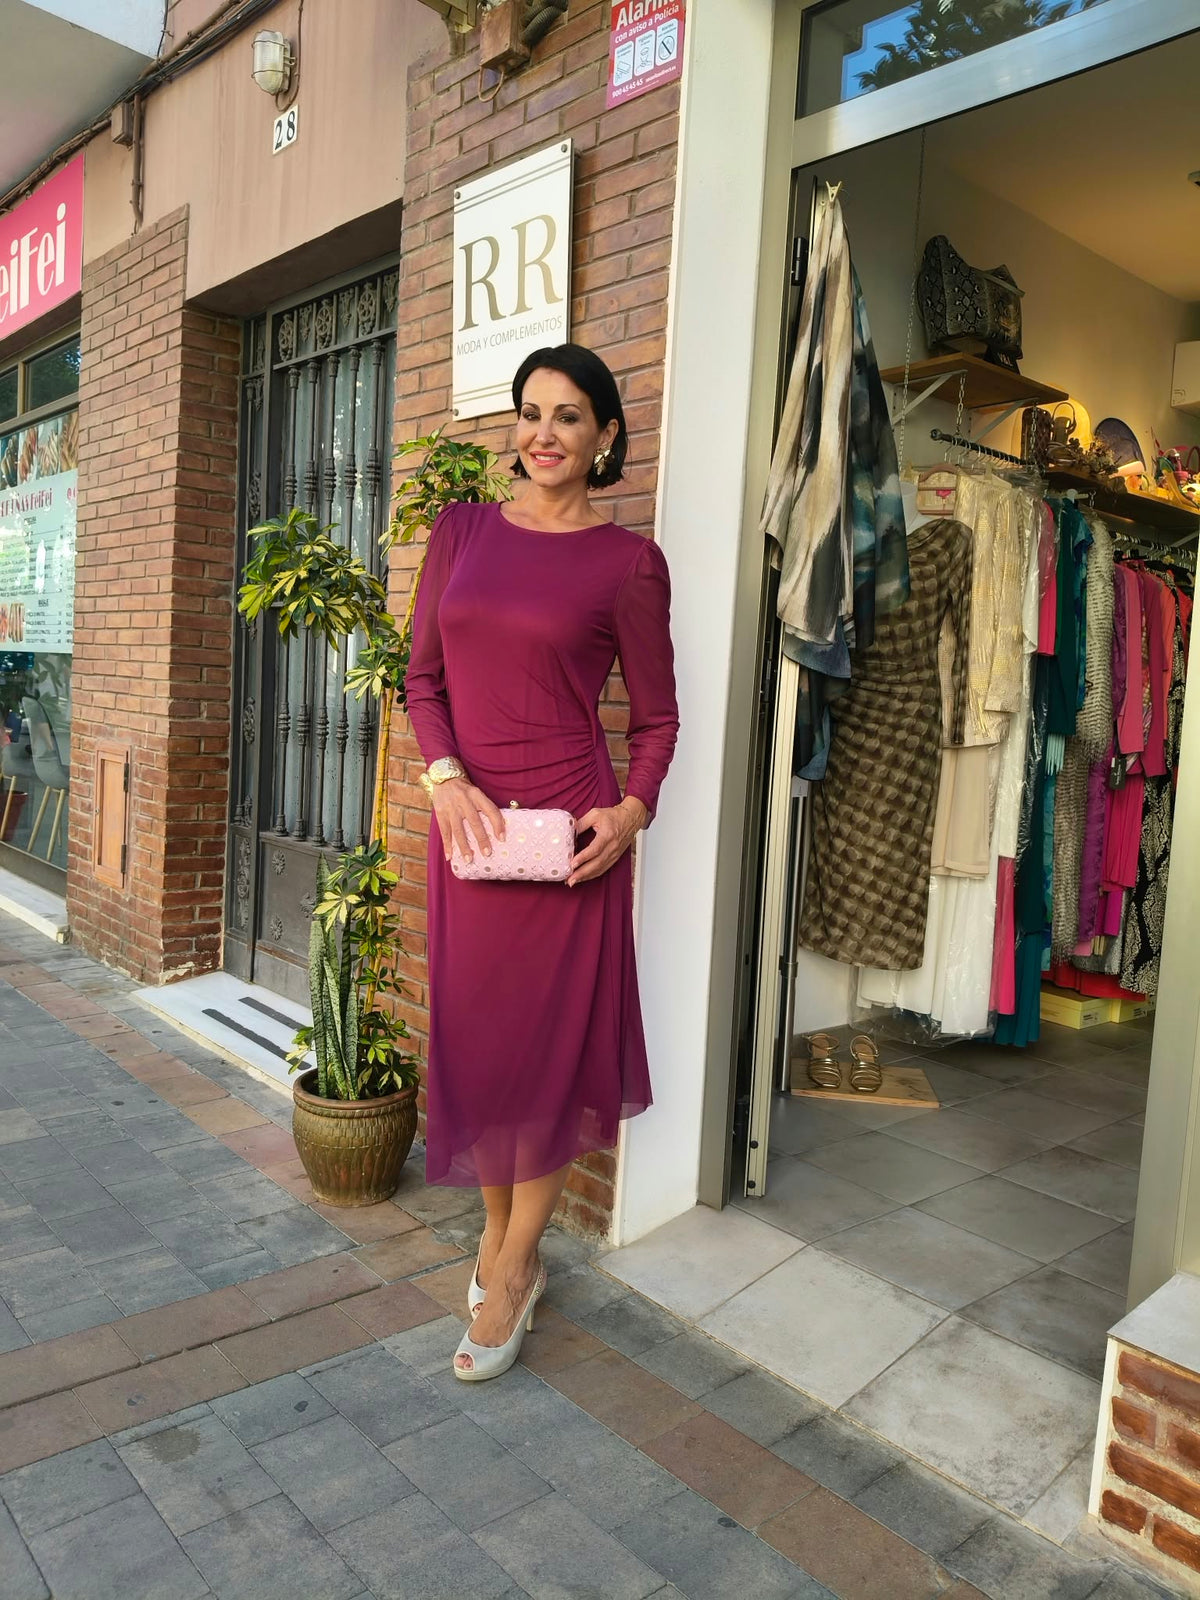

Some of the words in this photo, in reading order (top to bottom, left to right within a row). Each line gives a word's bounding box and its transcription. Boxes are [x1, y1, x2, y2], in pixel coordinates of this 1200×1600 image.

[615, 32, 628, 44] con
[629, 22, 647, 37] aviso
[648, 18, 653, 26] a
[616, 0, 675, 31] Alar
[275, 110, 295, 150] 28
[458, 214, 563, 332] RR
[457, 340, 481, 356] MODA
[483, 336, 489, 349] Y
[489, 315, 562, 347] COMPLEMENTOS
